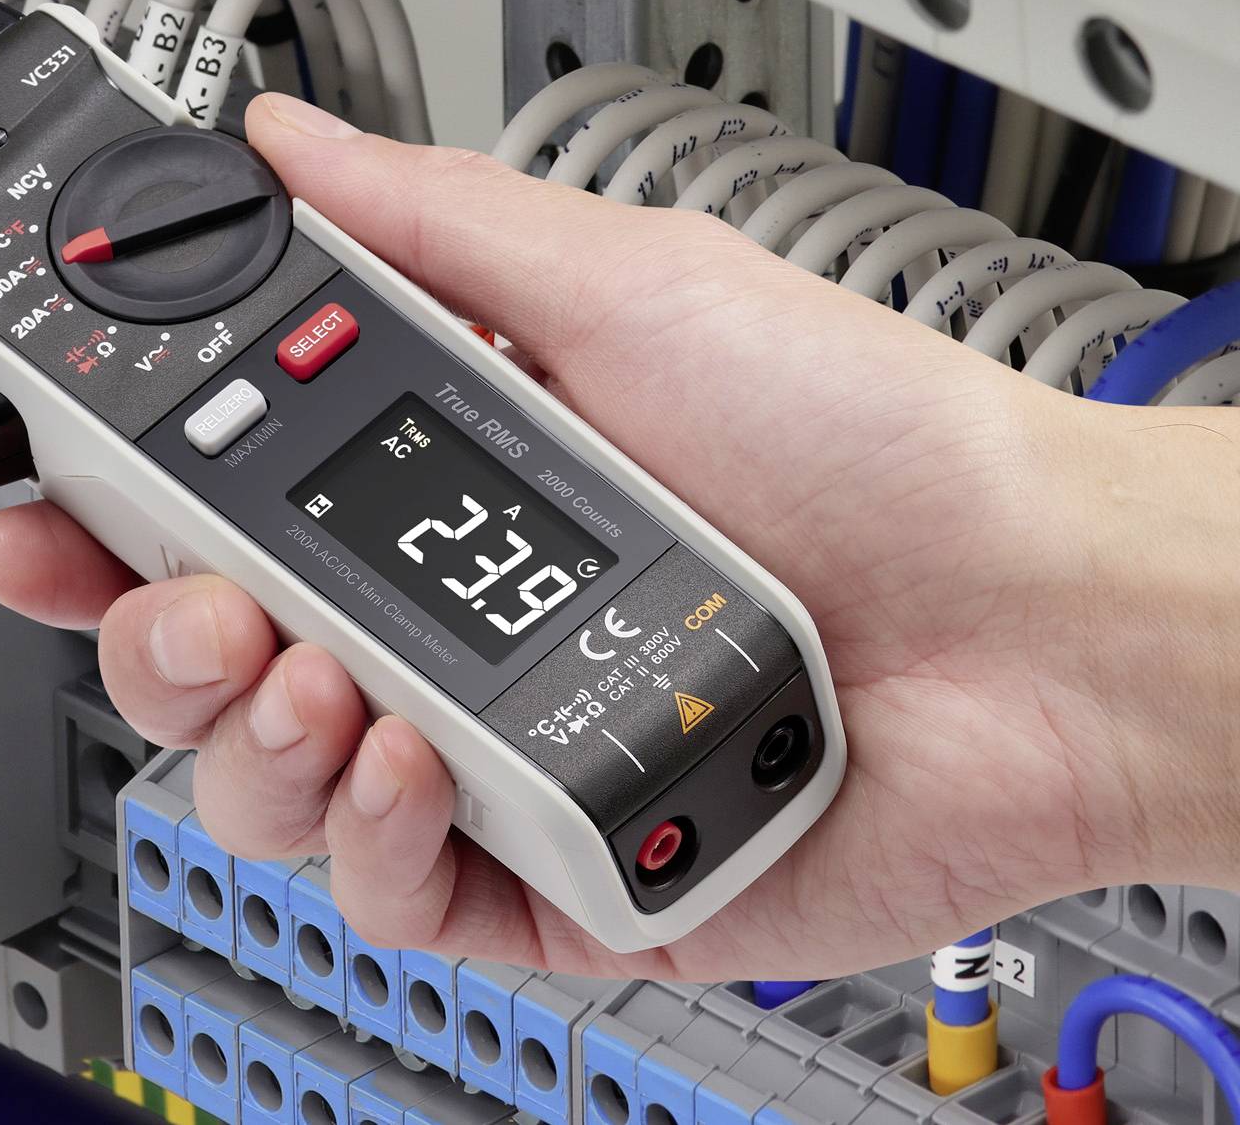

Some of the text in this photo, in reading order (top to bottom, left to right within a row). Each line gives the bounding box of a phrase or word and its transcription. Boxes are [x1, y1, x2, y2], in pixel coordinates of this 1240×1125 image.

[20, 44, 77, 88] VC331
[6, 163, 49, 200] NCV
[197, 328, 233, 363] OFF
[289, 310, 343, 358] SELECT
[434, 381, 530, 460] True RMS
[380, 434, 413, 460] AC
[502, 504, 523, 521] A
[536, 468, 624, 539] 2000 Counts
[397, 494, 578, 636] 23.9
[285, 524, 459, 667] 200A AC/DC Mini Clamp Meter
[684, 592, 728, 631] COM
[578, 606, 642, 661] CE
[597, 626, 671, 692] CAT III 300V
[609, 635, 682, 702] CAT II 600V
[954, 952, 991, 982] N
